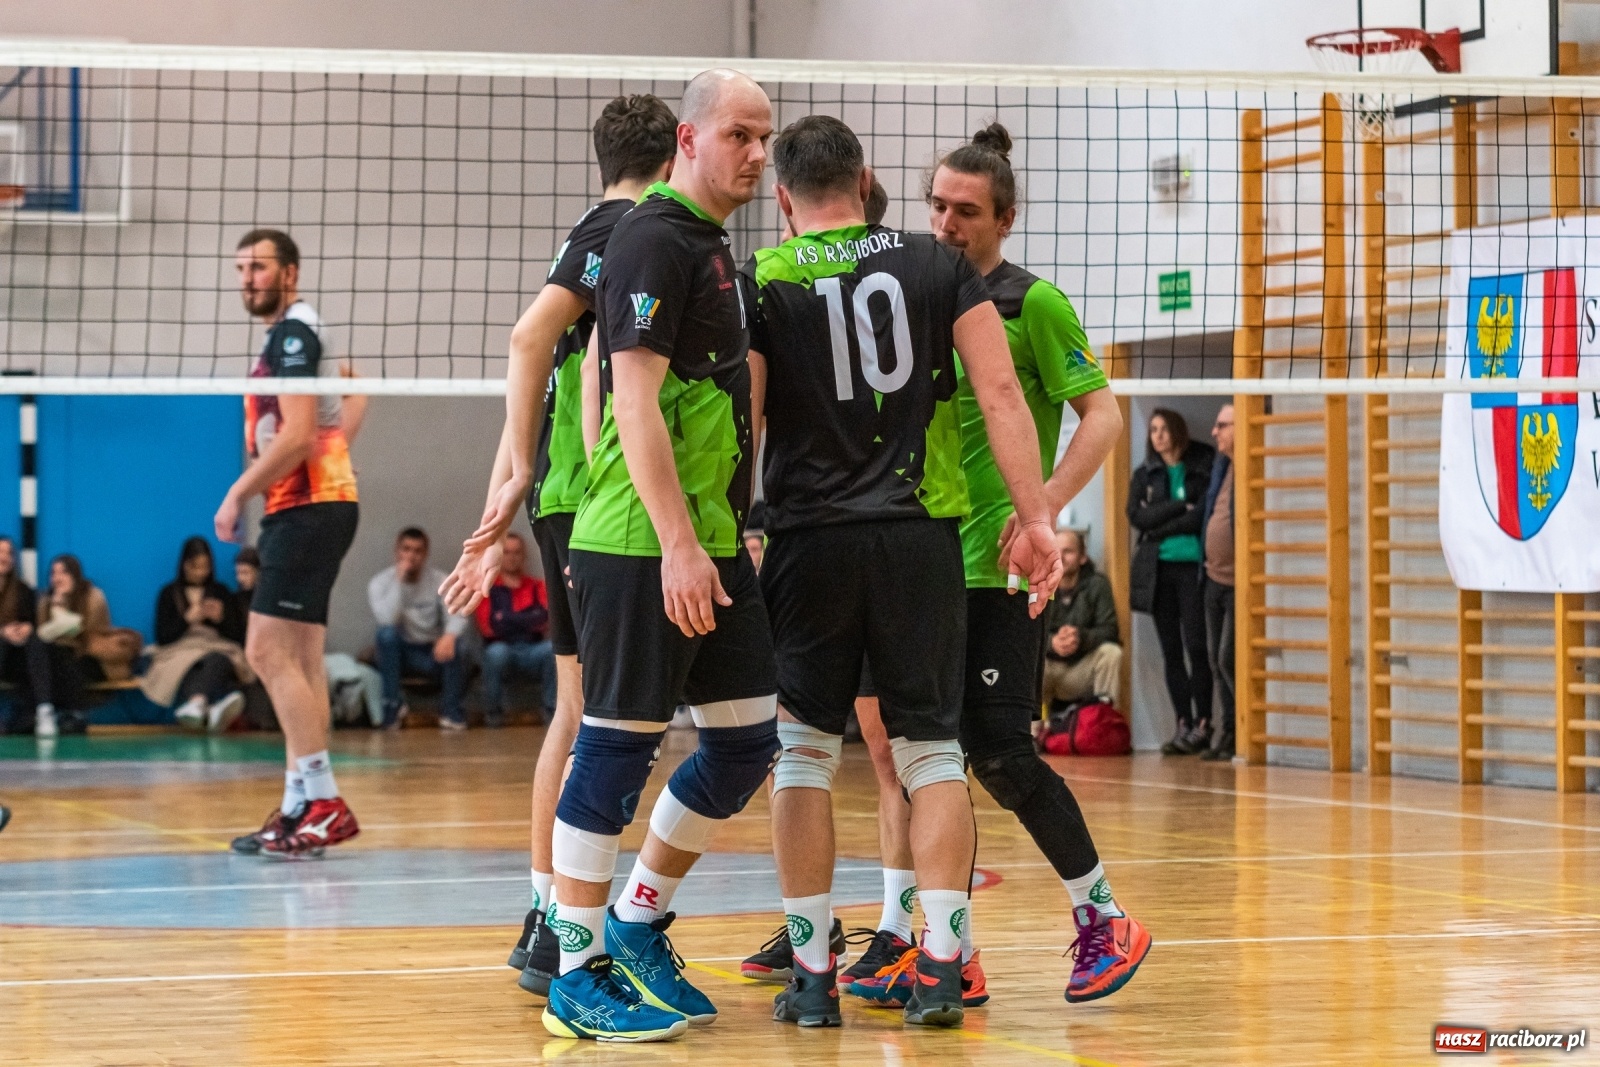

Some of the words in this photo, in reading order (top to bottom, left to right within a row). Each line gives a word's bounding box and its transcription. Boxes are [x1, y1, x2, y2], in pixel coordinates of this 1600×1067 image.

[795, 246, 819, 266] KS
[581, 272, 598, 286] PCS
[635, 316, 652, 326] PCS
[814, 271, 914, 401] 10
